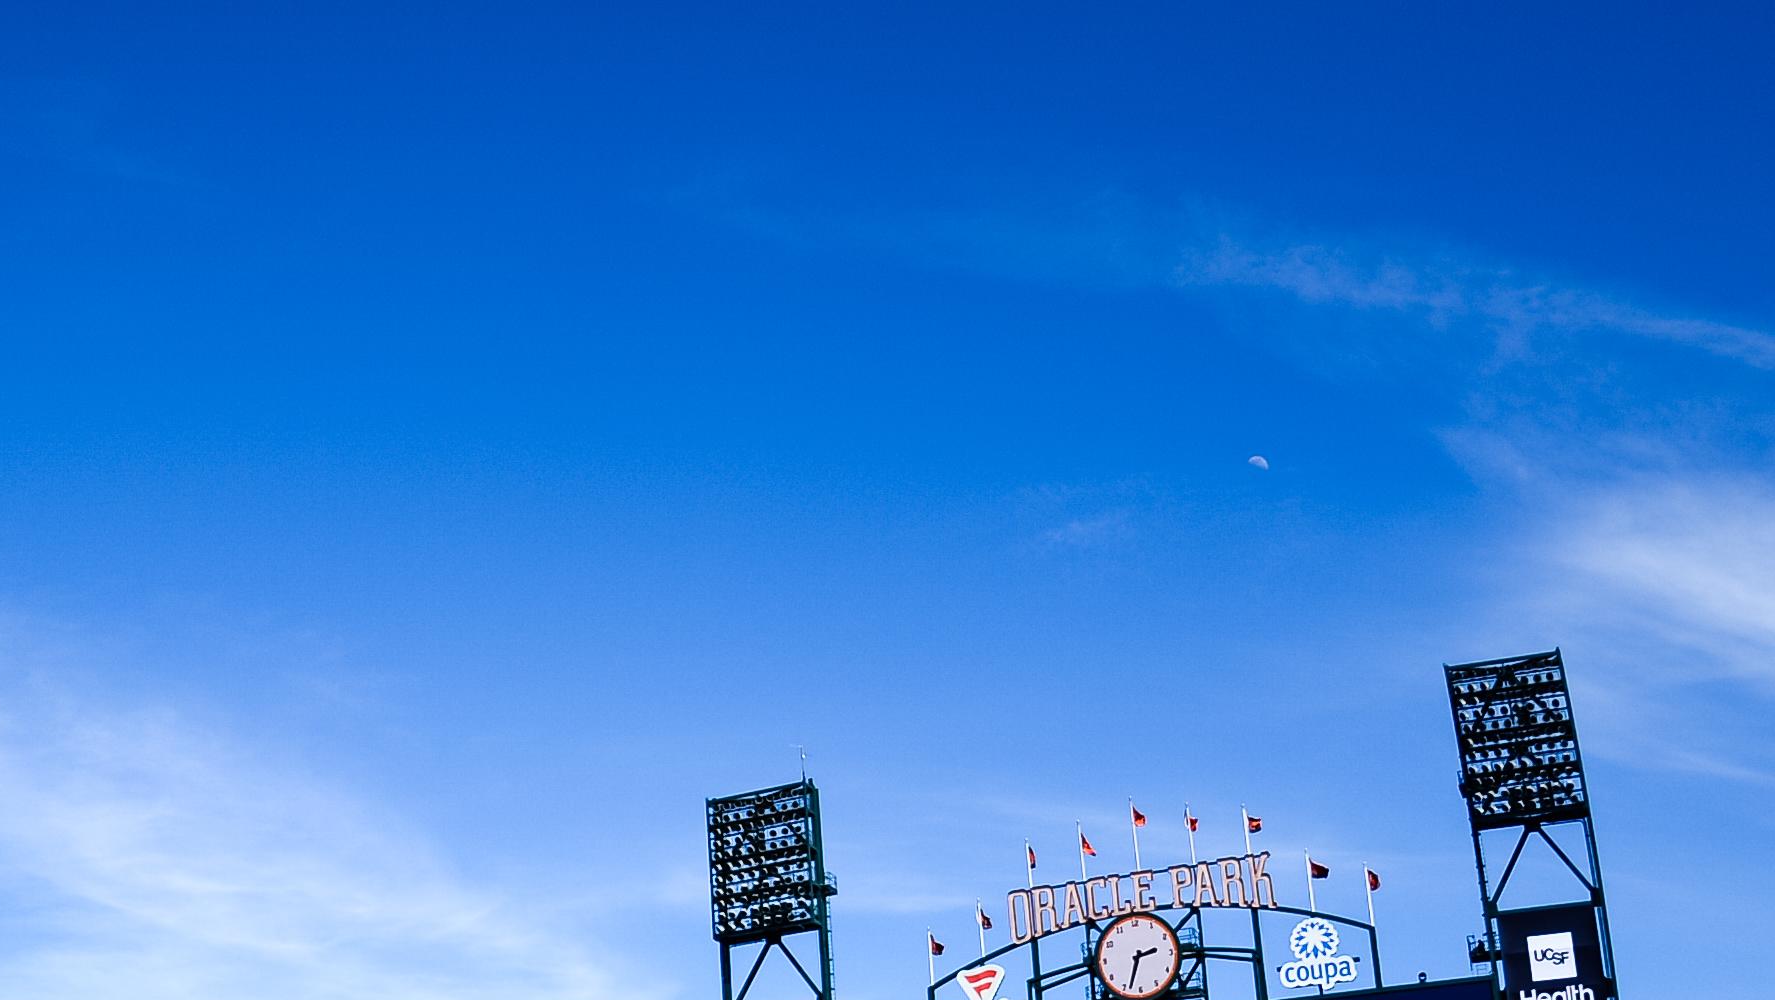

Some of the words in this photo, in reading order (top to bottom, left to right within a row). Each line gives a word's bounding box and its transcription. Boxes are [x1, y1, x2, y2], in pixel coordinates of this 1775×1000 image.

[1008, 869, 1157, 945] ORACLE
[1168, 850, 1277, 909] PARK
[1534, 947, 1569, 966] UCSF
[1284, 958, 1352, 985] coupa
